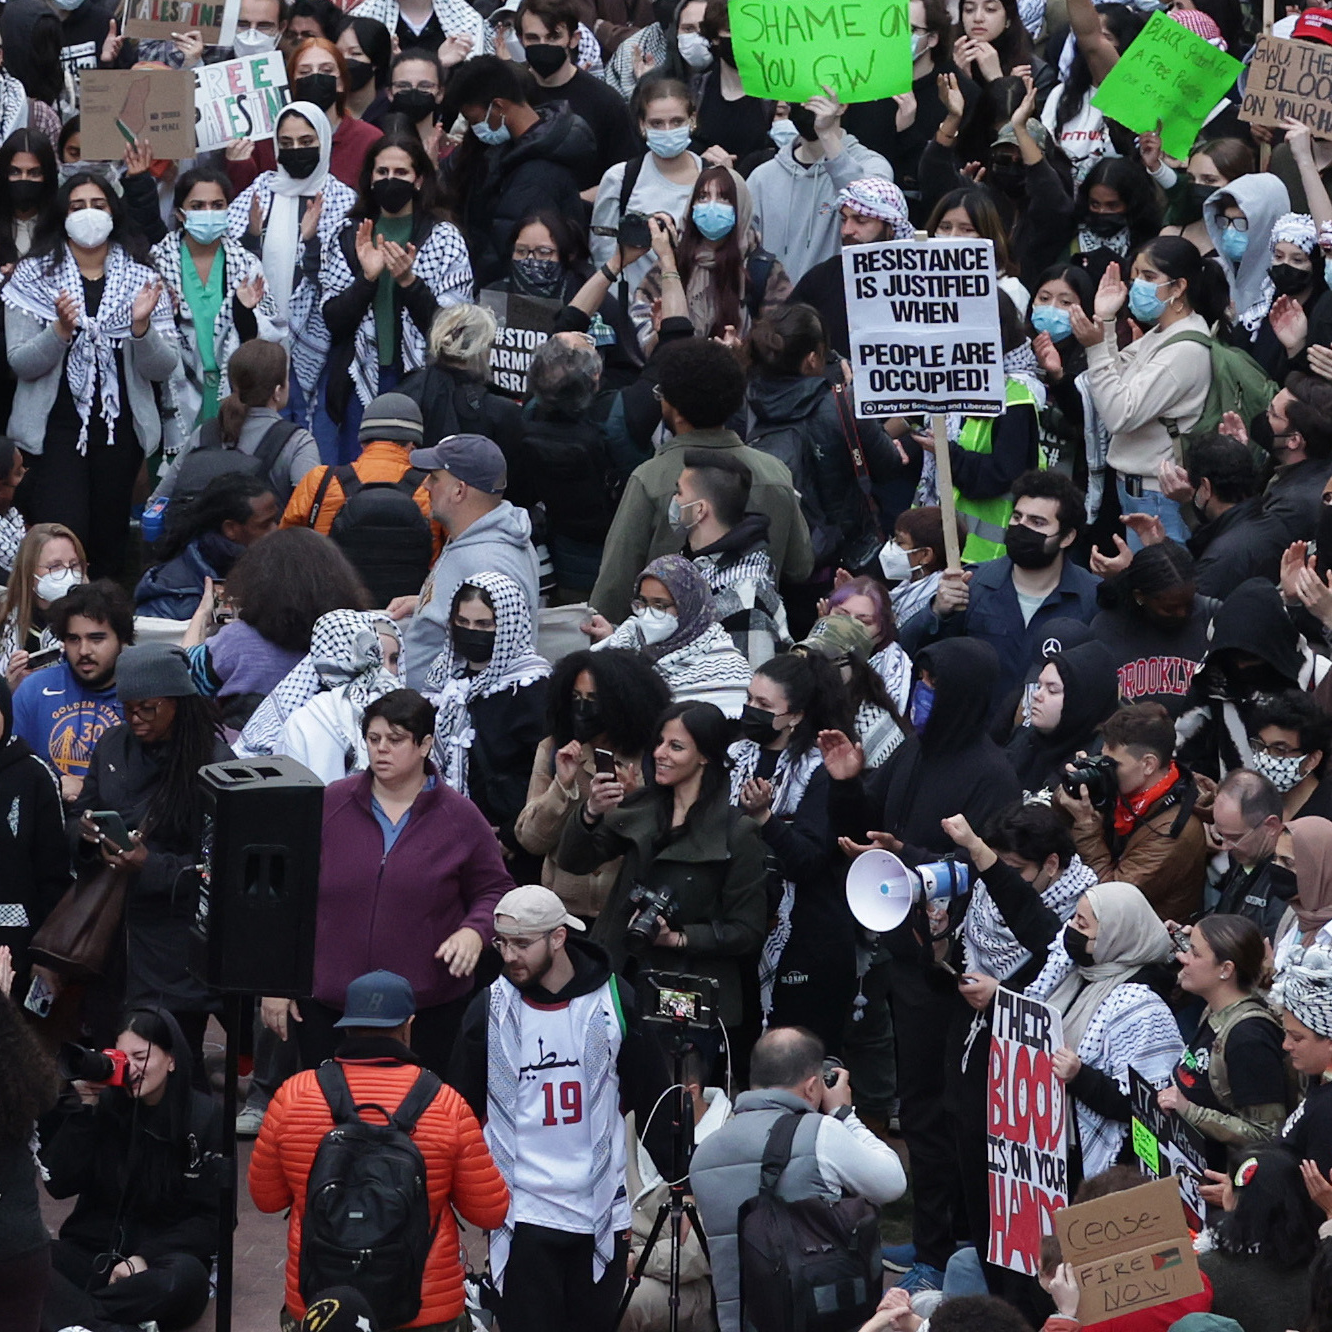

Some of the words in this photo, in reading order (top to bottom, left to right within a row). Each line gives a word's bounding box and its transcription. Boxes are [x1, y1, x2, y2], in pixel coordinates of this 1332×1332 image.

[739, 2, 866, 46] SHAME
[1143, 15, 1187, 54] BLACK
[751, 50, 796, 92] YOU
[811, 49, 876, 94] GW
[1243, 94, 1266, 116] ON
[1273, 96, 1317, 123] YOUR
[852, 247, 989, 274] RESISTANCE
[855, 277, 878, 299] IS
[882, 273, 990, 299] JUSTIFIED
[889, 300, 959, 324] WHEN
[495, 326, 549, 351] #STOP
[859, 343, 945, 369] PEOPLE
[951, 342, 997, 366] ARE
[868, 369, 990, 395] OCCUPIED!
[877, 403, 896, 413] Party
[911, 403, 945, 412] Socialism
[963, 402, 1001, 412] Liberation
[51, 701, 95, 720] GOLDEN
[79, 722, 104, 743] 30
[998, 987, 1052, 1053] THEIR
[541, 1080, 583, 1127] 19
[988, 1035, 1065, 1152] BLOOD
[1033, 1149, 1068, 1195] YOUR
[1080, 1255, 1145, 1289] FIRE
